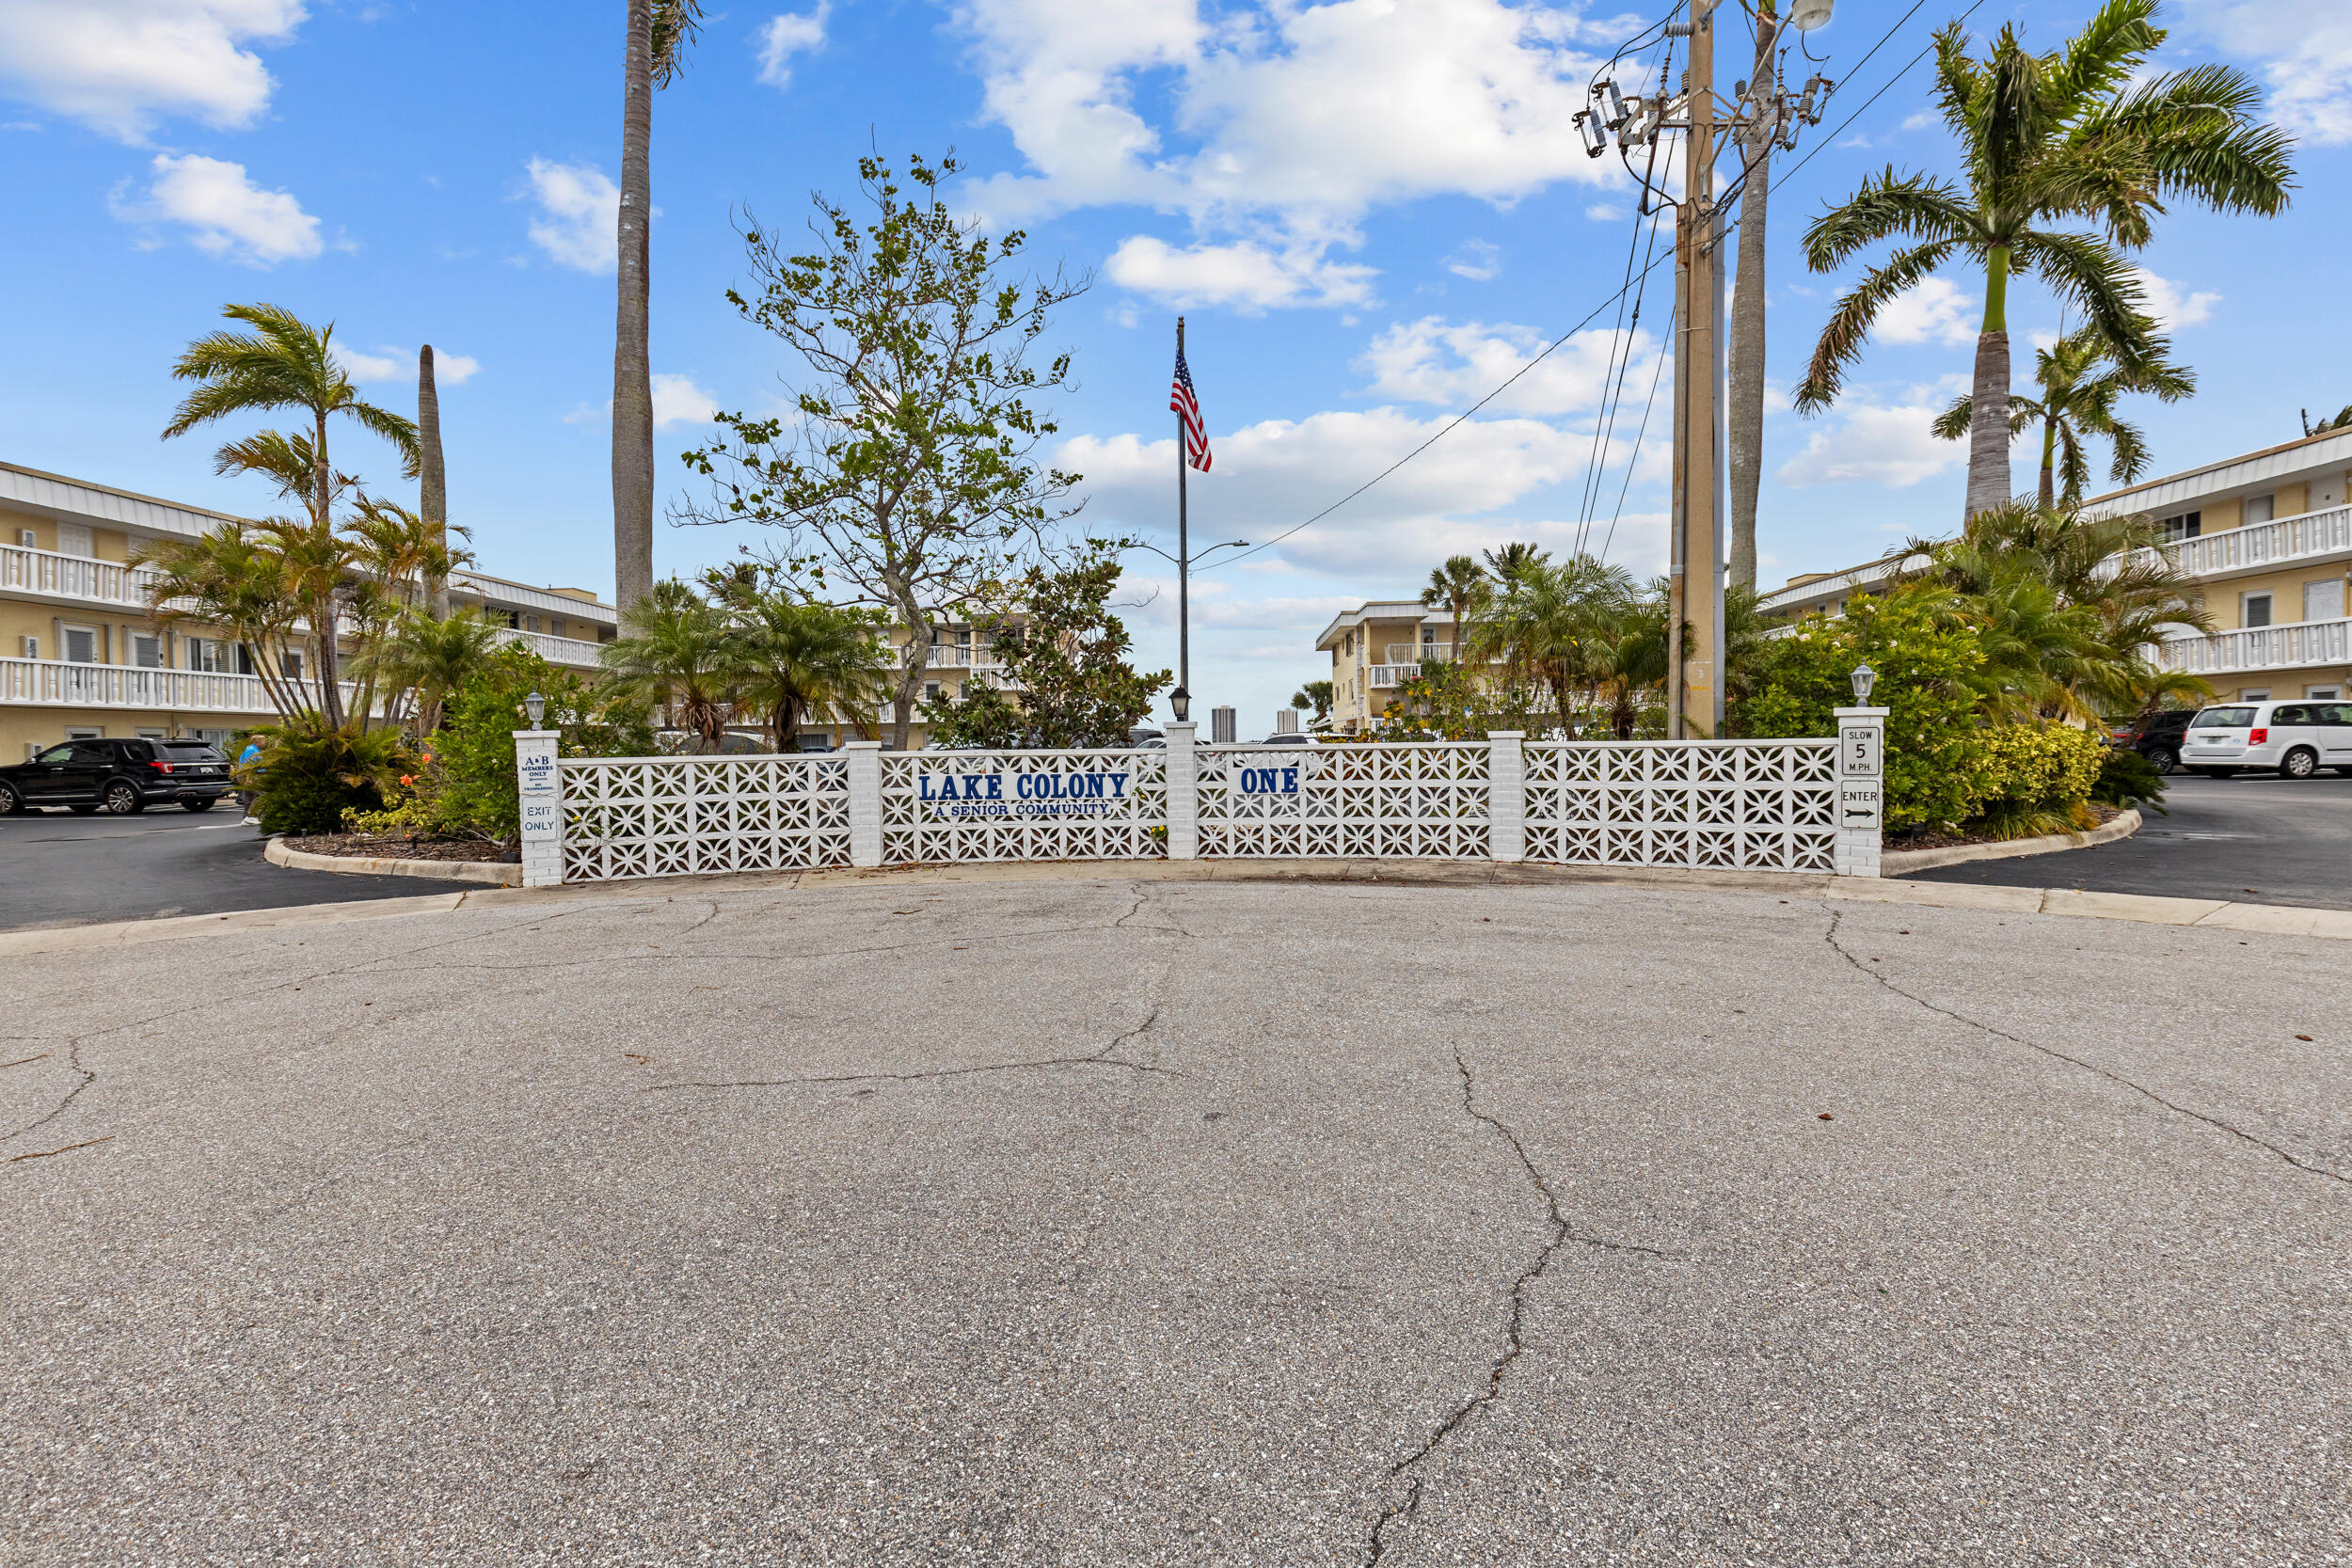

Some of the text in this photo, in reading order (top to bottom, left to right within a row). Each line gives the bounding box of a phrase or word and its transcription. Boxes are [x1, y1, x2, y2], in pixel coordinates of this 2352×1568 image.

[1849, 731, 1872, 739] SLOW
[1855, 743, 1866, 759] 5
[526, 756, 534, 765] A
[542, 755, 549, 765] B
[1241, 768, 1298, 794] ONE
[918, 773, 1129, 800] LAKE COLONY
[1842, 791, 1878, 801] ENTER
[527, 806, 551, 816] EXIT
[934, 803, 1109, 816] A SENIOR COMMUNITY
[525, 821, 554, 831] ONLY
